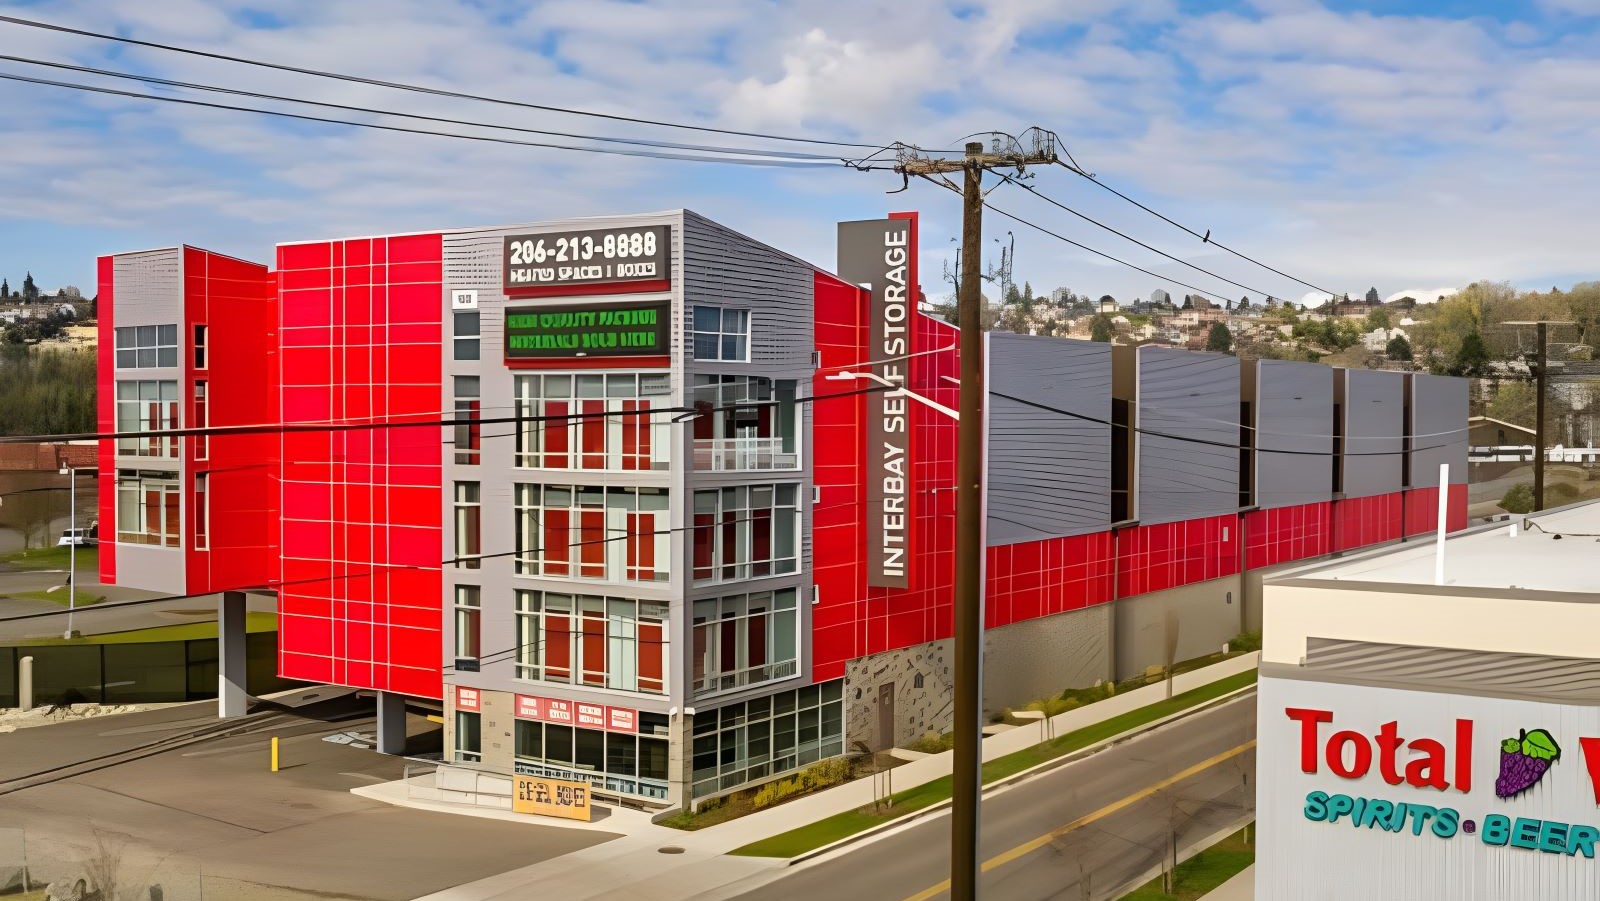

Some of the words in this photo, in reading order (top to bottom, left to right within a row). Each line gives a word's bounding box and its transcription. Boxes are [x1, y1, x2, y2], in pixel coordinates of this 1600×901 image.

[884, 229, 907, 355] STORAGE
[883, 445, 905, 577] INTERBAY
[1285, 707, 1474, 794] Total
[1303, 791, 1460, 839] SPIRITS
[1481, 813, 1600, 859] BEER
